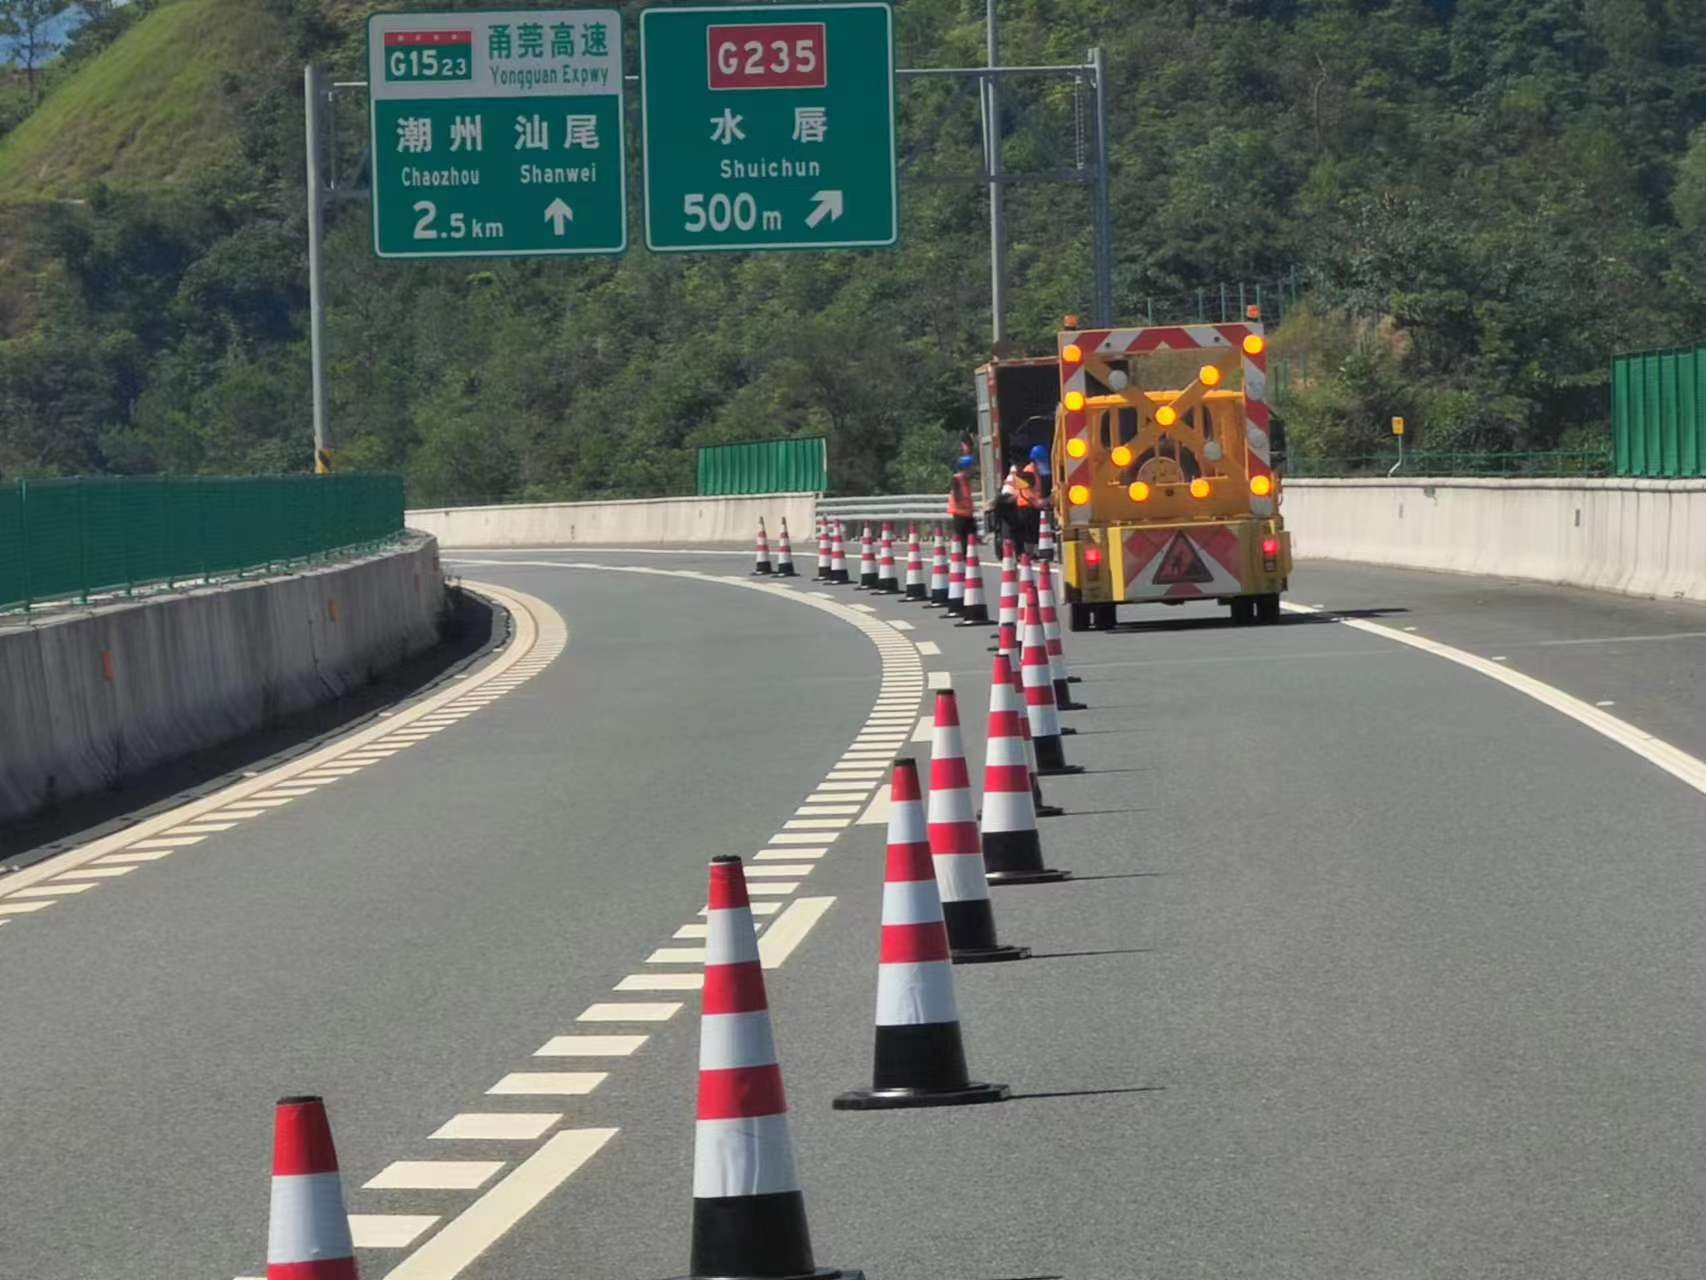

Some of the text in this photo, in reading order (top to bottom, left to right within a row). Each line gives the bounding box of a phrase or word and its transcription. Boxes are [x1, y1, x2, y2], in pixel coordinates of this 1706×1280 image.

[488, 21, 609, 60] 甬莞高速
[717, 39, 816, 75] G235
[490, 64, 609, 90] Yongguan Expwy
[396, 114, 483, 153] 潮州
[514, 113, 601, 151] 汕尾
[401, 166, 480, 187] Chaozhou
[520, 162, 597, 185] Shanwei
[720, 156, 820, 179] Shuichun
[413, 200, 504, 240] 2.5 km
[683, 192, 782, 233] 500 m
